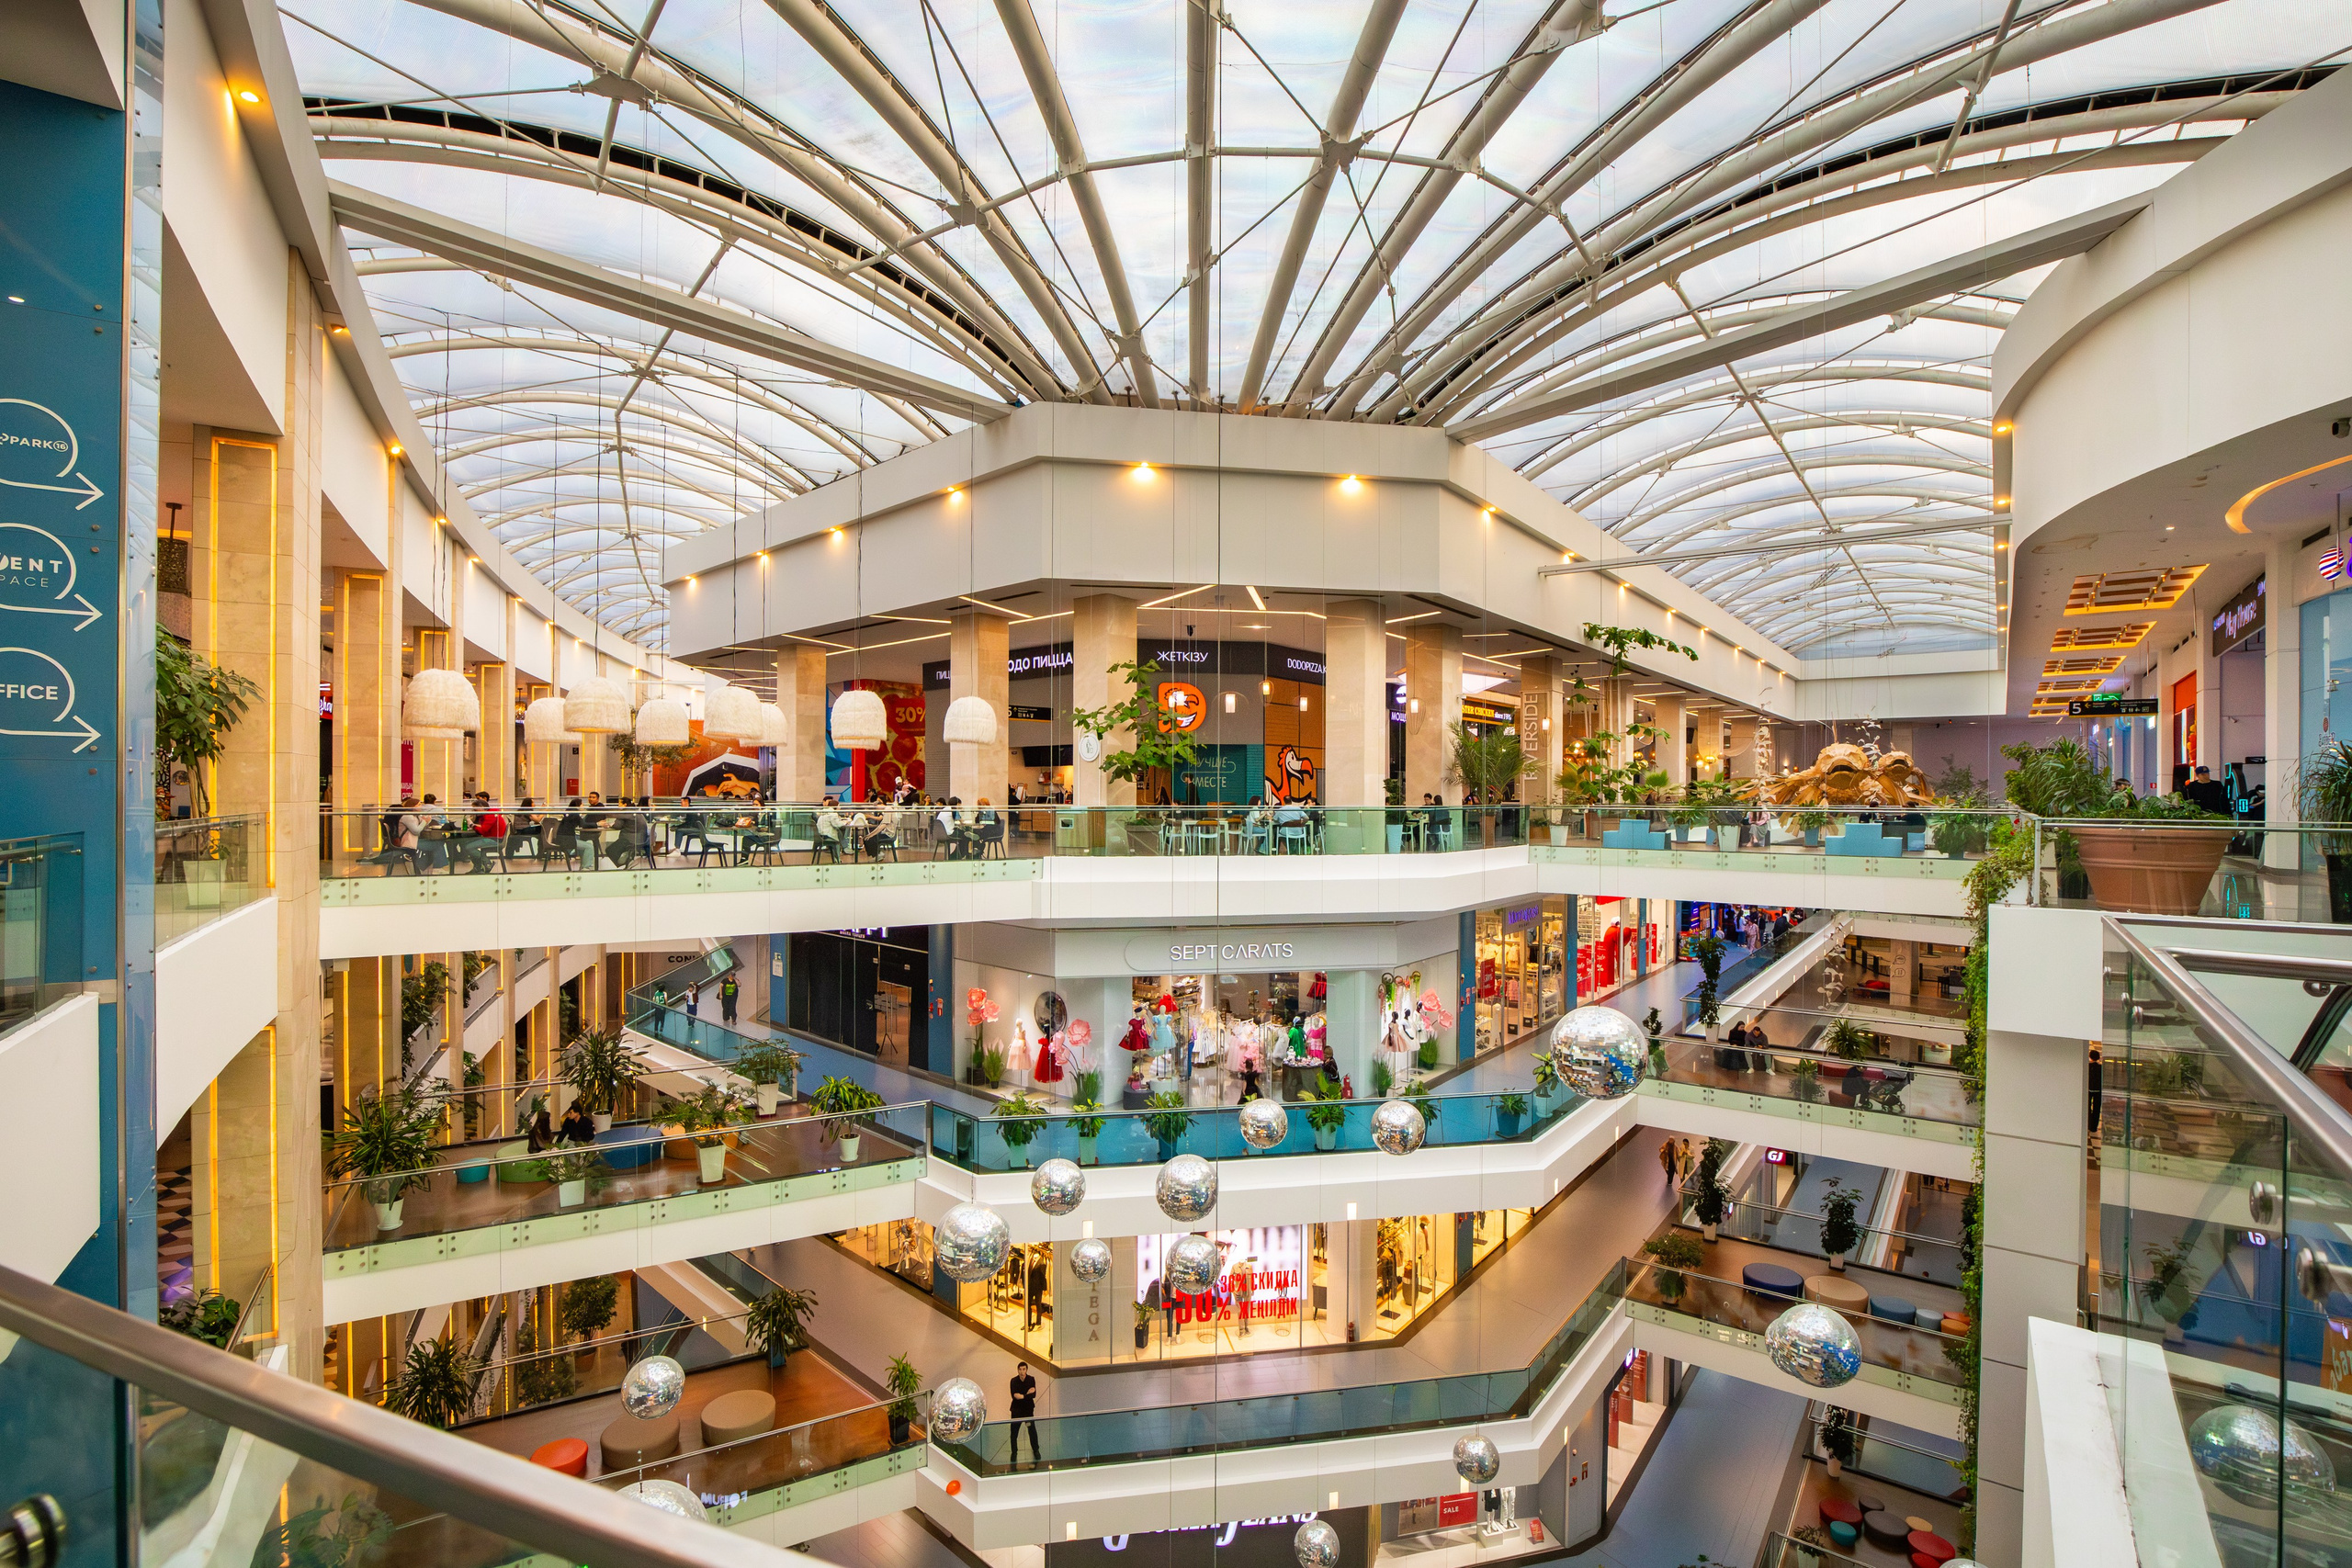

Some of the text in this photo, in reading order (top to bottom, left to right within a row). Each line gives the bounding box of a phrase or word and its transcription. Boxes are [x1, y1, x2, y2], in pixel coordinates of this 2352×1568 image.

[1033, 651, 1073, 668] ПИЦЦА
[1156, 650, 1209, 662] ЖЕТКІЗУ
[2072, 703, 2082, 714] 5
[1523, 694, 1538, 780] RVERSIDE
[1191, 756, 1227, 768] УЧШЕ
[1192, 776, 1227, 788] МЕСТЕ
[1170, 944, 1218, 961] SEPT
[1768, 1150, 1783, 1162] GJ
[1250, 1269, 1298, 1292] СКИДКА
[1442, 1506, 1459, 1515] SALE
